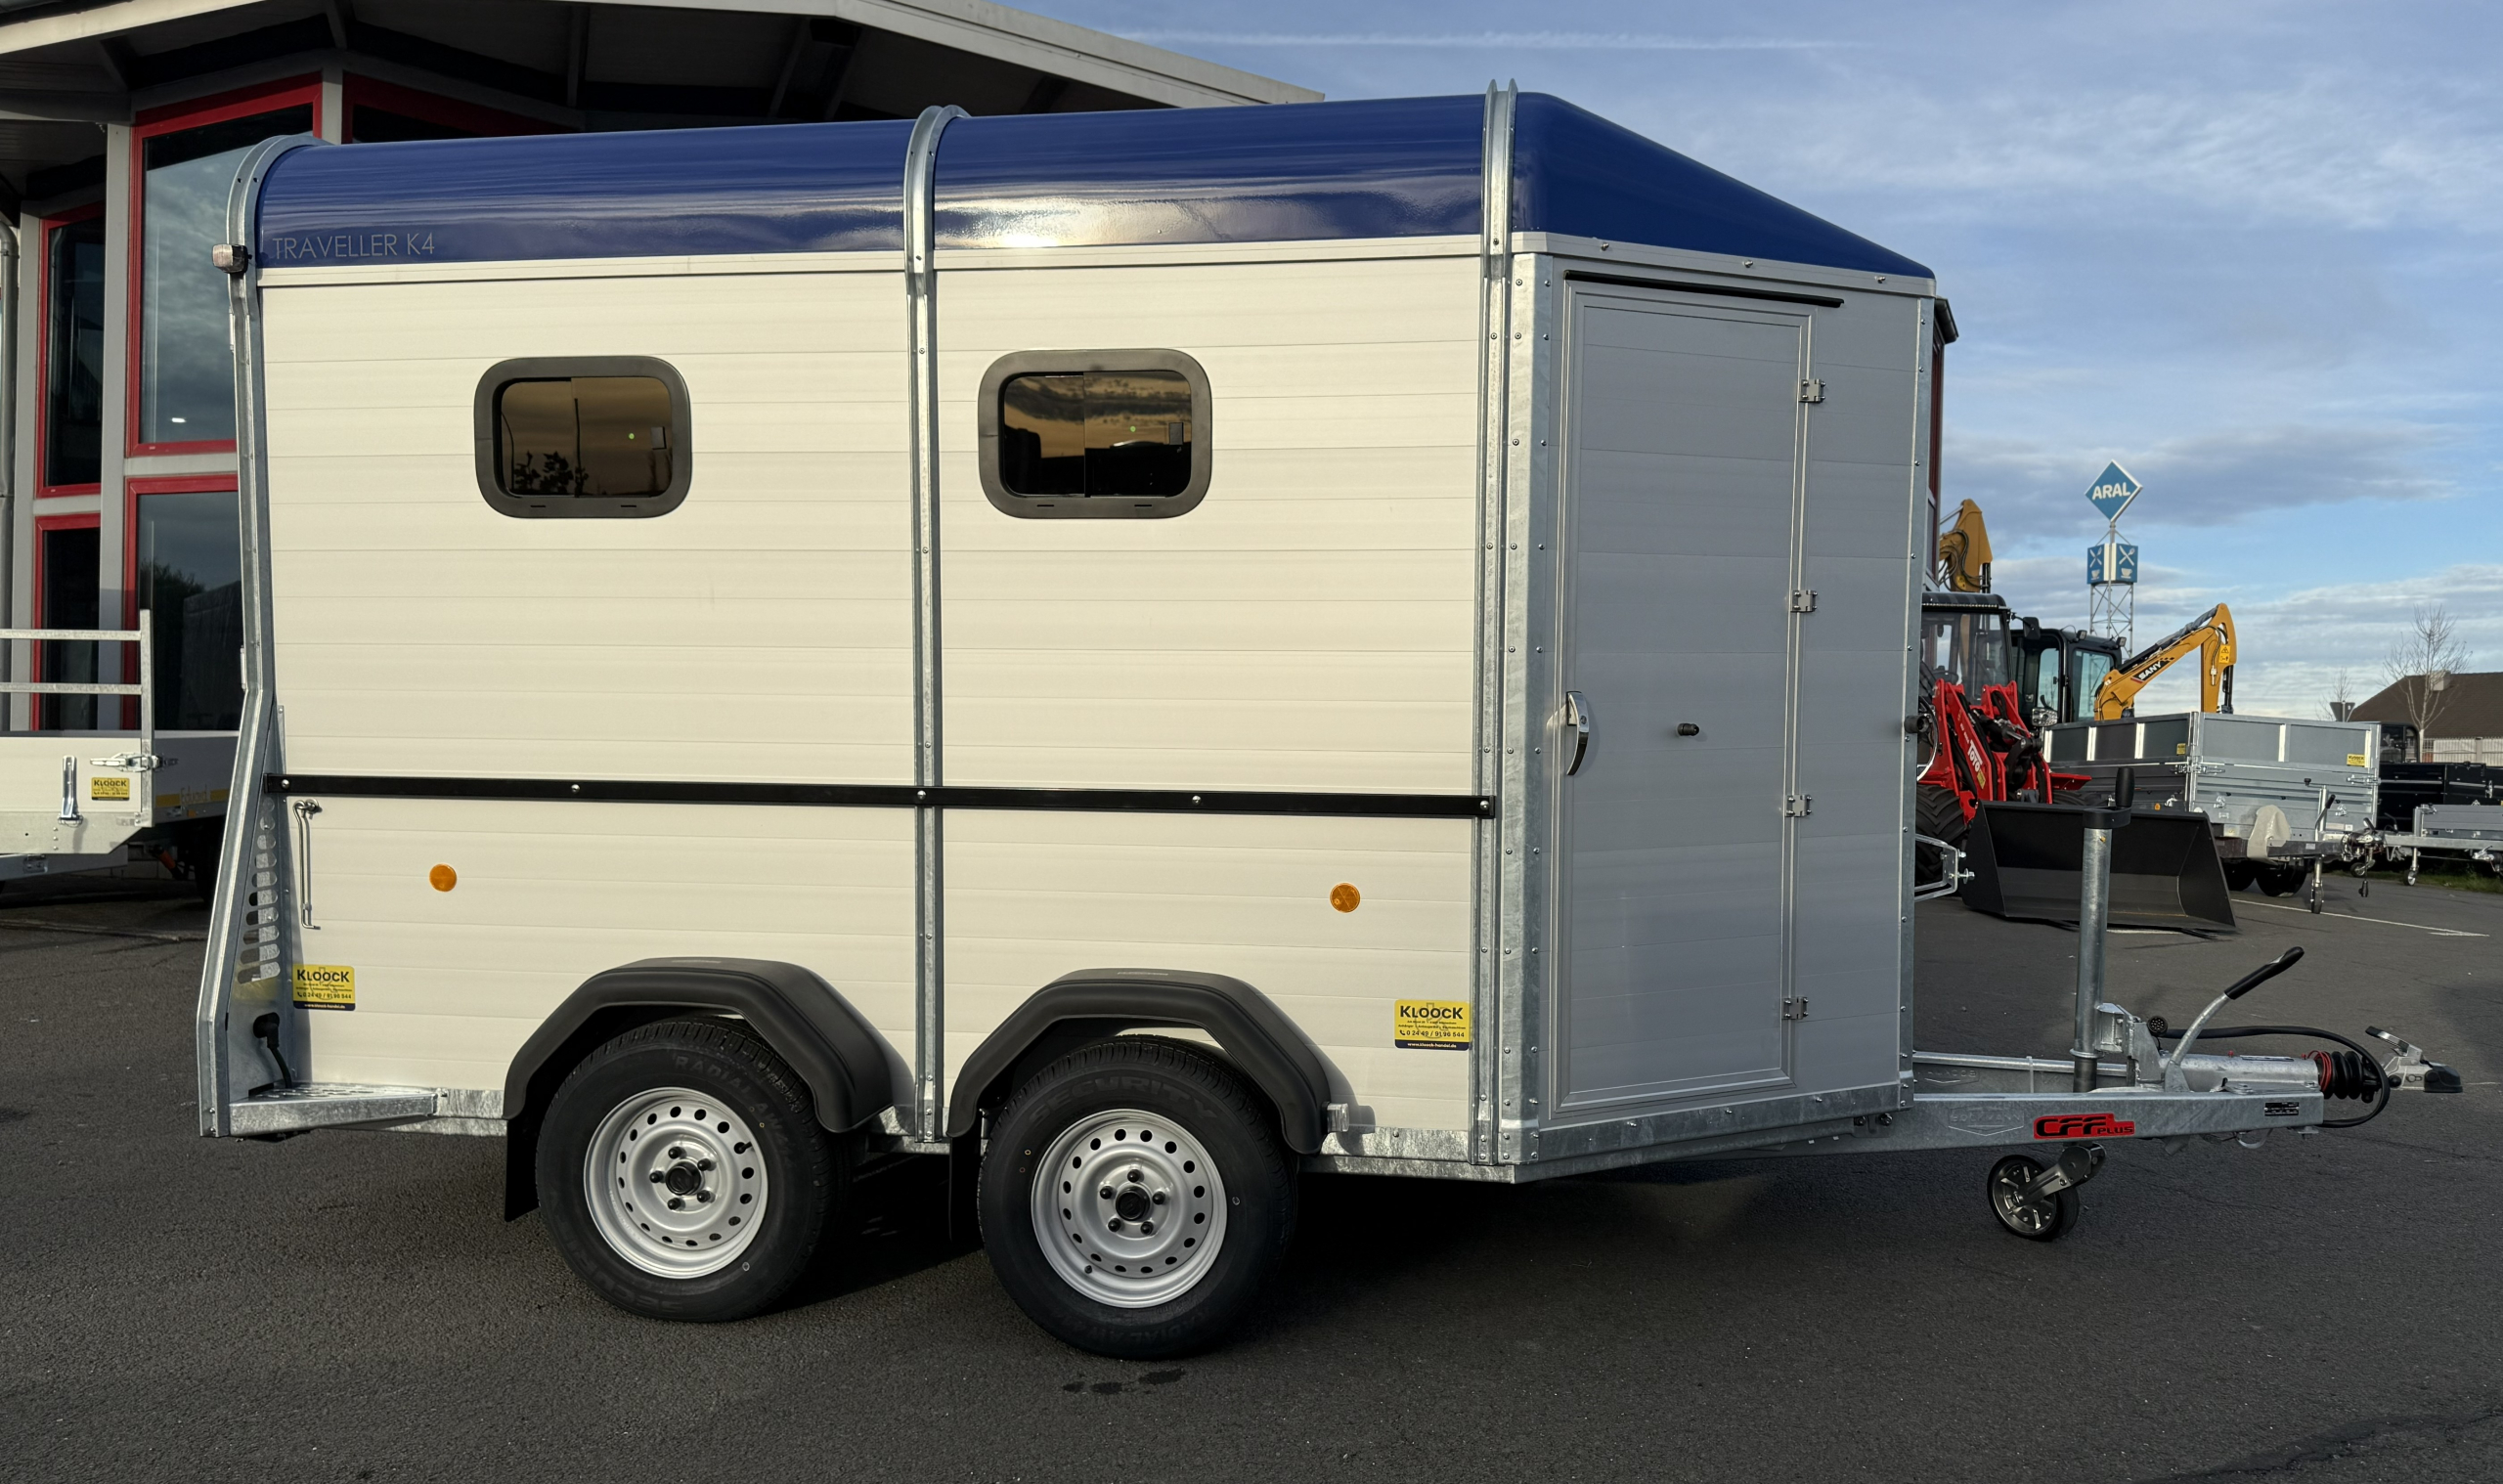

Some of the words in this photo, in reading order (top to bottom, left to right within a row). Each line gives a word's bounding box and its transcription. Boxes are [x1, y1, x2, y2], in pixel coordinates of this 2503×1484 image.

[272, 234, 398, 260] TRAVELLER
[407, 232, 435, 256] K4
[2091, 482, 2131, 501] ARAL
[2137, 661, 2163, 680] SANY
[296, 969, 350, 982] KLOOCK
[1400, 1005, 1464, 1020] KLOOCK
[1029, 1076, 1217, 1124] SECURITY
[2096, 1126, 2133, 1135] PLUS
